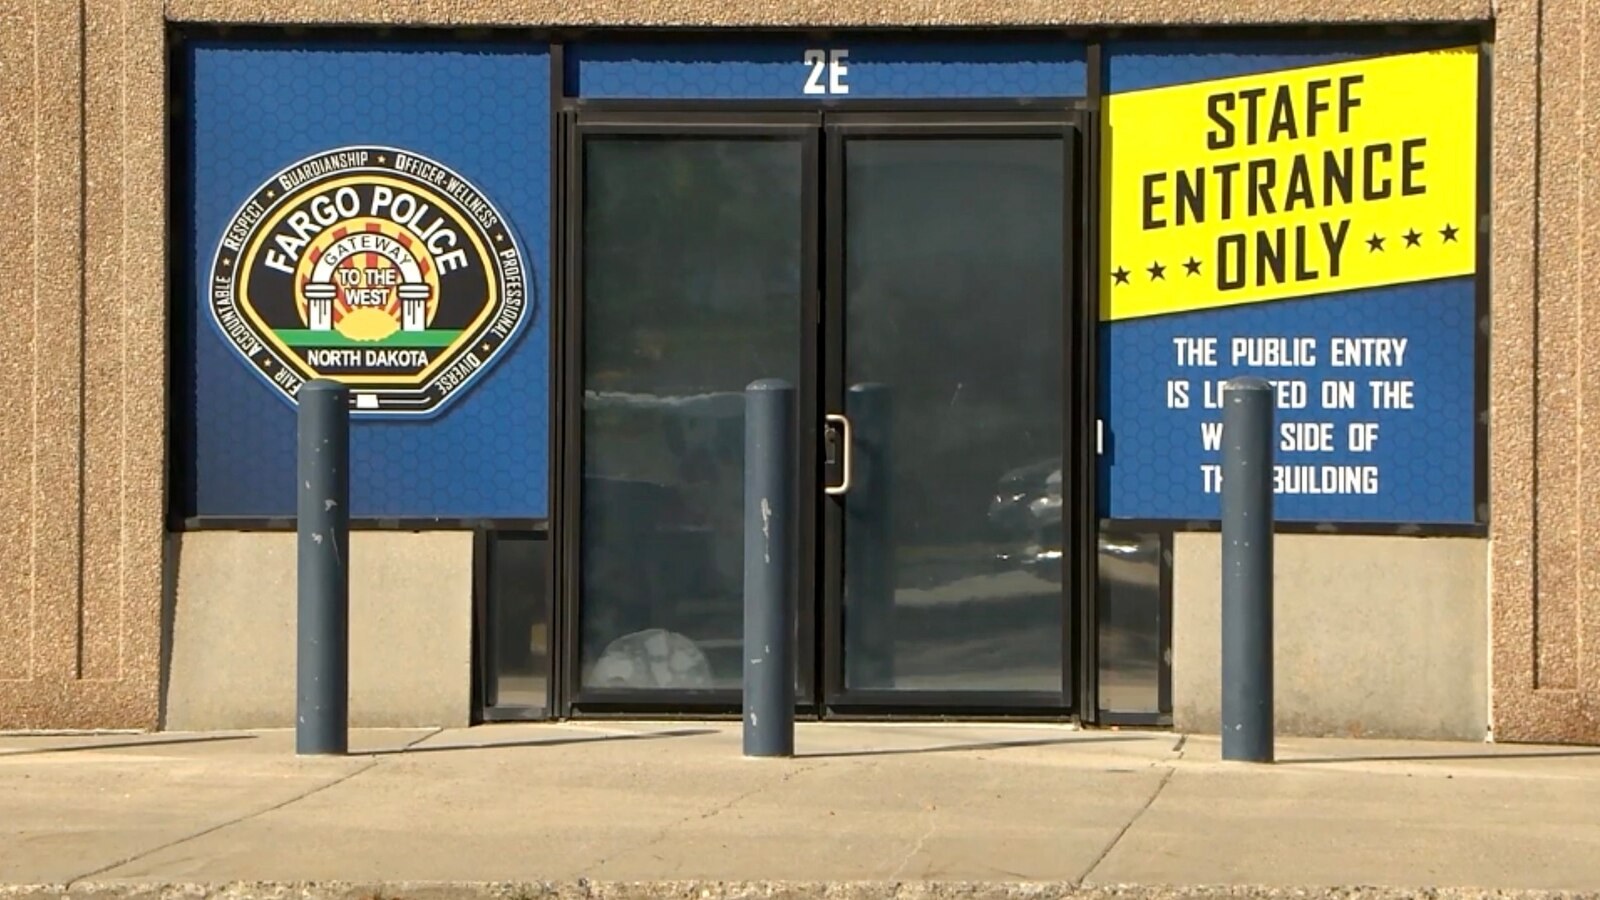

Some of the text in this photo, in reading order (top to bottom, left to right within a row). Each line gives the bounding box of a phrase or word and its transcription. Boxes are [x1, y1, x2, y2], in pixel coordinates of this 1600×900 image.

[803, 49, 849, 94] 2E
[1206, 74, 1364, 151] STAFF
[278, 151, 369, 191] GUARDIANSHIP
[395, 153, 498, 229] OFFICER-WELLNESS
[1142, 137, 1427, 231] ENTRANCE
[223, 199, 265, 251] RESPECT
[264, 185, 468, 275] FARGO POLICE
[324, 235, 412, 267] GATEWAY
[1216, 219, 1352, 292] ONLY
[338, 268, 397, 286] TO THE
[345, 287, 390, 305] WEST
[491, 248, 522, 339] PROFESSIONAL
[214, 275, 263, 357] ACCOUNTABLE
[307, 350, 429, 366] NORTH DAKOTA
[437, 351, 481, 396] DIVERSE
[1173, 337, 1408, 367] THE PUBLIC ENTRY
[273, 367, 303, 396] FAIR
[1167, 380, 1190, 409] IS
[1321, 380, 1355, 409] ON
[1369, 380, 1414, 409] THE
[1280, 422, 1379, 451] SIDE OF
